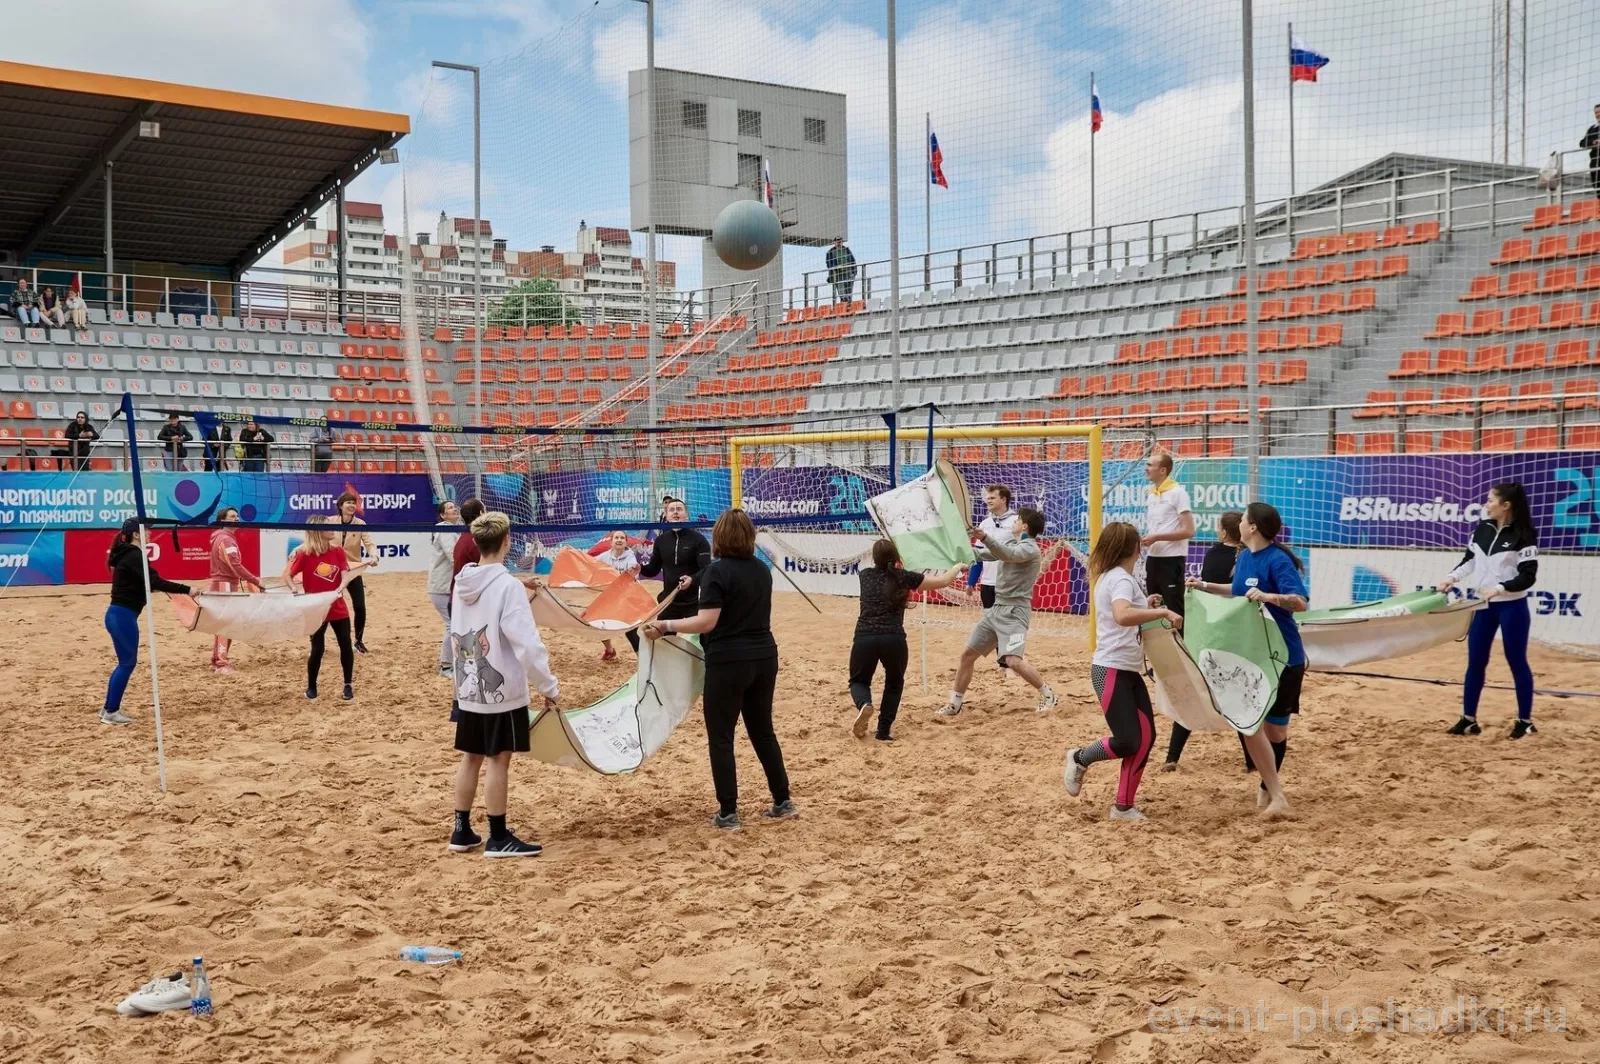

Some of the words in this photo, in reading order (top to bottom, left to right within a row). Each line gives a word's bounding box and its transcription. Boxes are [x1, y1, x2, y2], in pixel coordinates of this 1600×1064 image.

[103, 489, 158, 506] РОССИ
[289, 493, 416, 510] САНКТ-ТЕРБУРГ
[742, 496, 819, 513] SRussia.com
